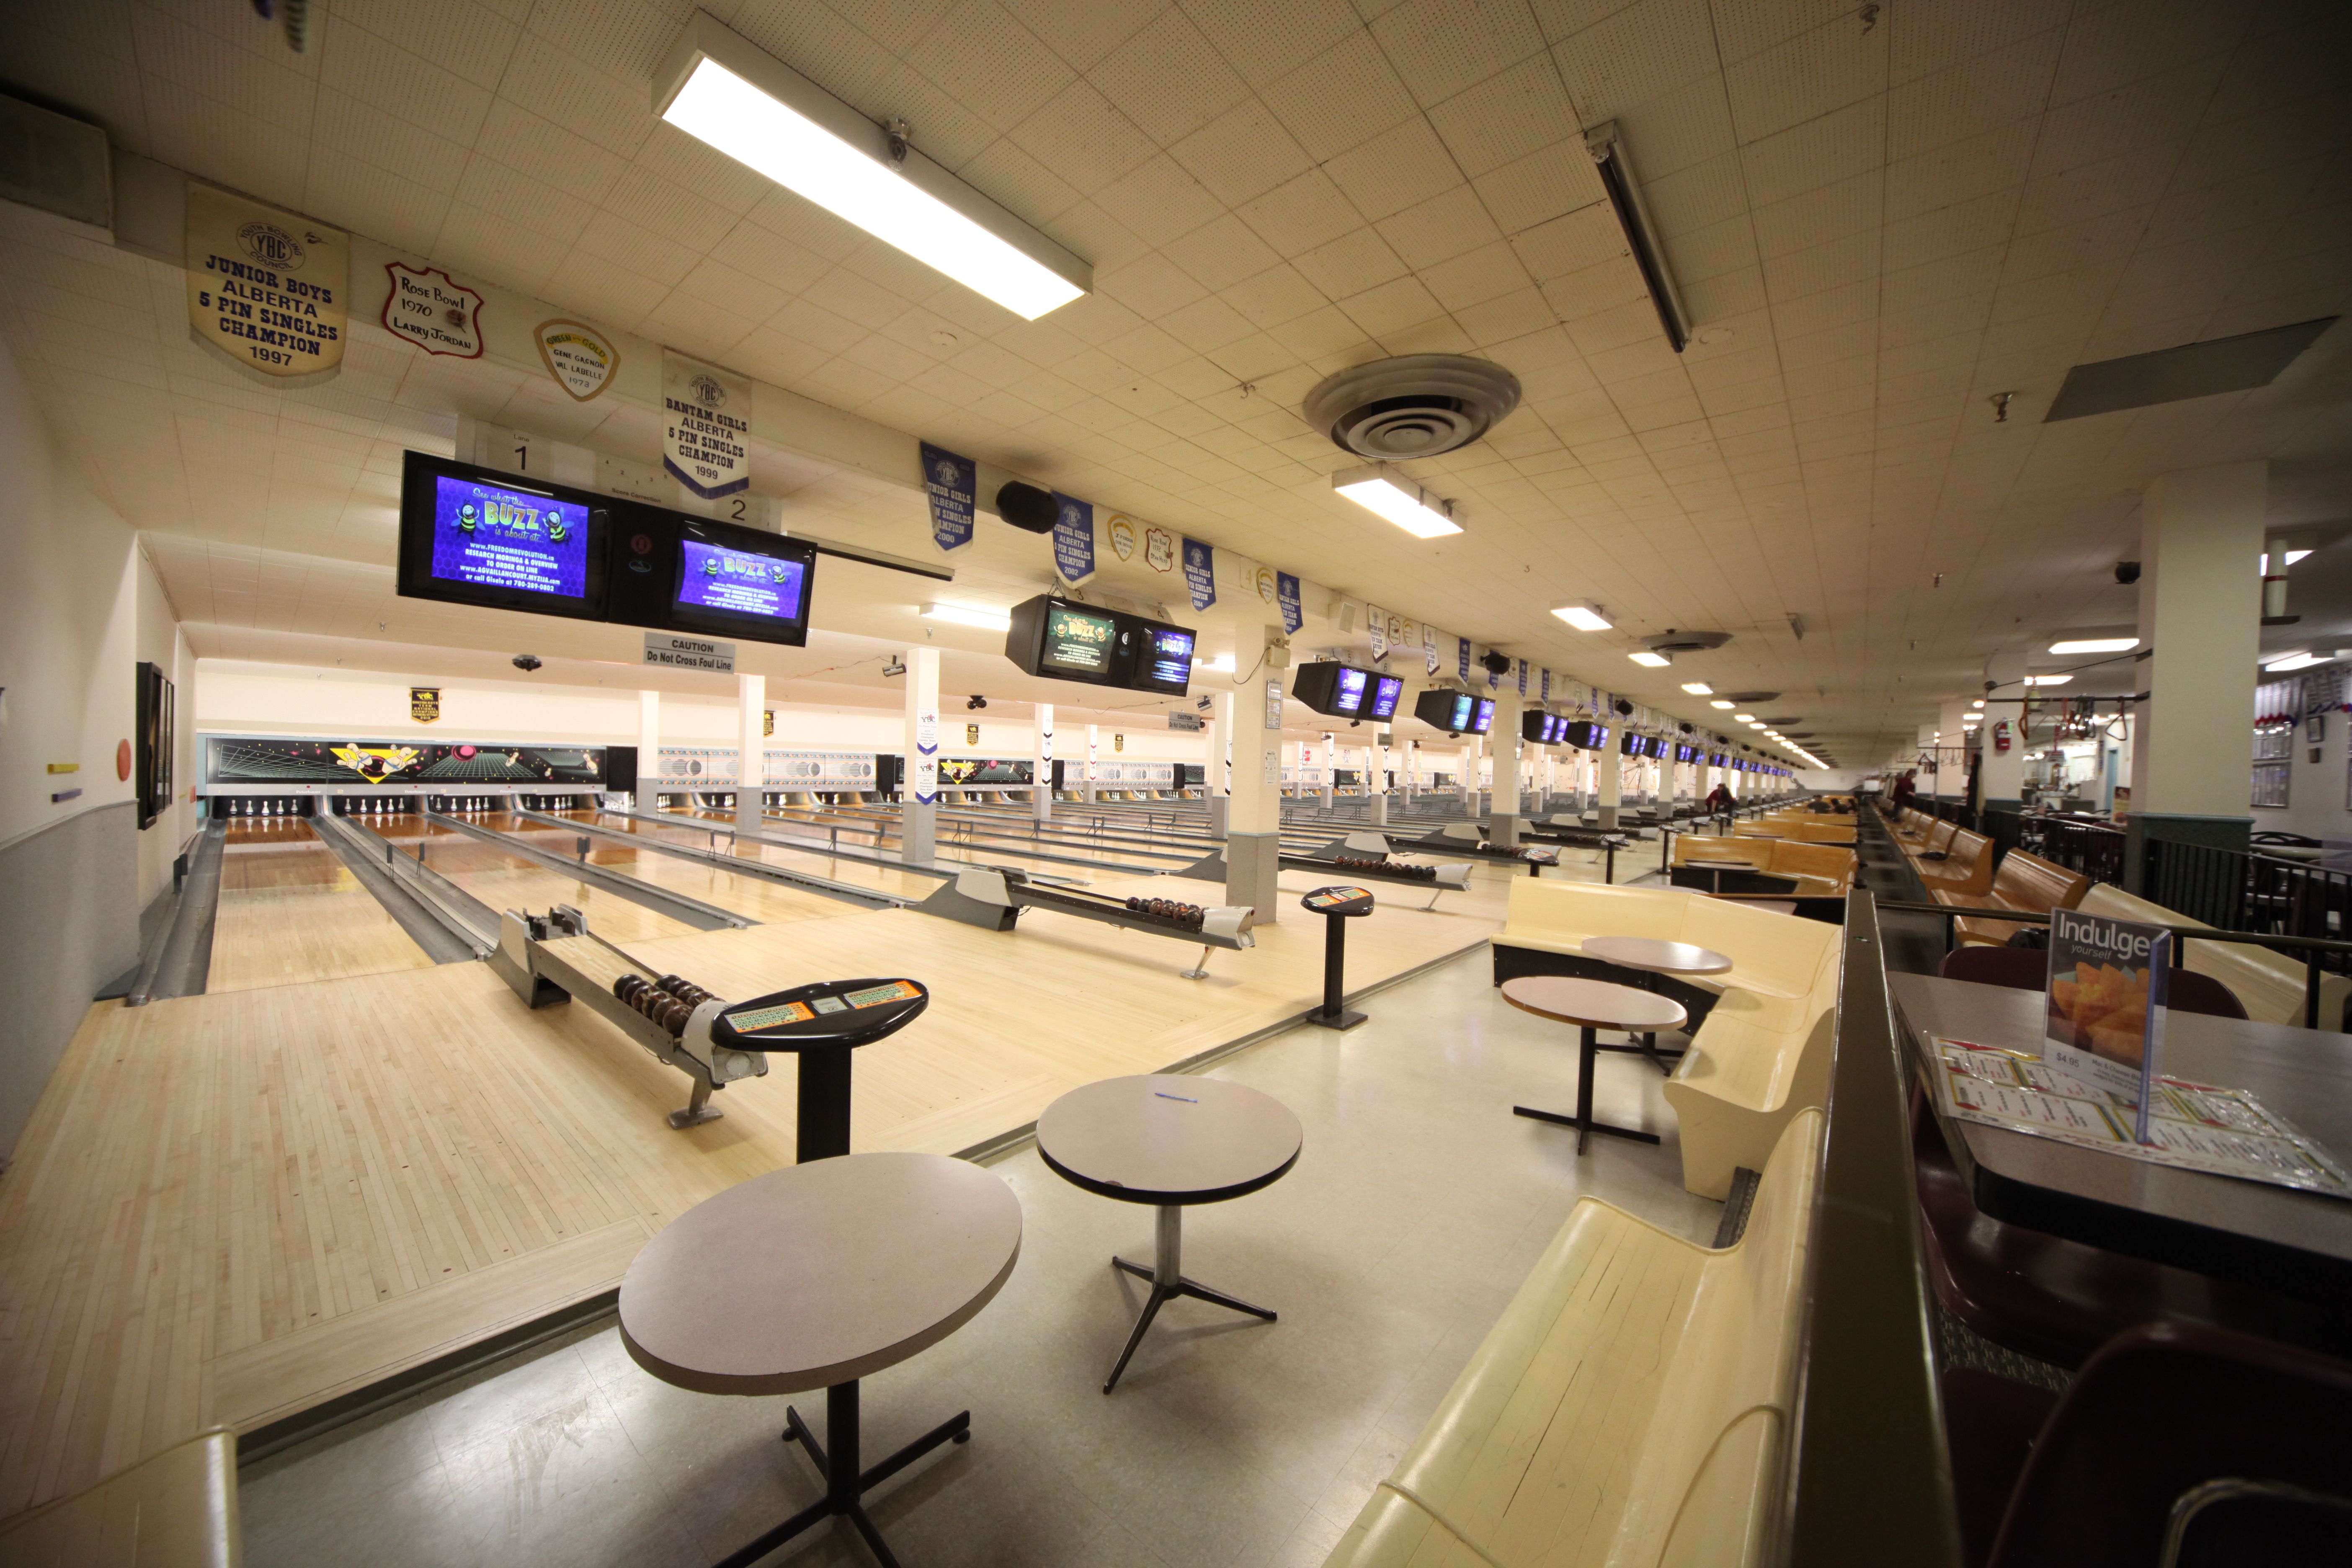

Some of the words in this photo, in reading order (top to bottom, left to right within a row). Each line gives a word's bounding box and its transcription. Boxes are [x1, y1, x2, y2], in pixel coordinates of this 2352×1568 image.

[240, 224, 264, 239] YOUTH
[267, 226, 302, 256] BOWLING
[257, 235, 286, 259] YBC
[250, 251, 294, 269] COUNCIL
[206, 254, 279, 288] JUNIOR
[286, 277, 333, 304] BOYS
[222, 280, 317, 318] ALBERTA
[402, 298, 432, 316] 1970
[199, 291, 210, 307] 5
[218, 296, 252, 319] PIN
[260, 308, 338, 340] SINGLES
[219, 317, 320, 356] CHAMPION
[547, 334, 571, 344] GREEN
[582, 339, 606, 357] GOLD
[249, 346, 292, 366] 1997
[554, 349, 572, 359] GENE
[575, 355, 604, 369] GAGNON
[556, 361, 568, 370] VAL
[572, 366, 602, 380] LABELLE
[569, 377, 589, 388] 1973
[691, 376, 704, 387] YOUTH
[705, 377, 725, 397] BOWLING
[699, 383, 716, 401] YBC
[696, 396, 720, 407] COUNCIL
[666, 397, 713, 422] BANTAM
[717, 414, 747, 432] GIRLS
[681, 417, 733, 441] ALBERTA
[669, 427, 674, 438] 5
[678, 429, 697, 444] PIN
[701, 436, 744, 458] SINGLES
[515, 446, 526, 470] 1
[679, 444, 733, 469] CHAMPION
[695, 465, 718, 479] 1999
[943, 467, 953, 481] YBC
[472, 487, 489, 498] See
[491, 493, 511, 502] what
[631, 493, 661, 503] Correction
[951, 490, 971, 504] GIRLS
[485, 501, 539, 530] BUZZ
[731, 499, 746, 521] 2
[943, 511, 972, 524] SINGLES
[495, 526, 501, 535] is
[505, 528, 529, 539] about
[938, 519, 965, 534] AMPION
[1055, 524, 1073, 536] JUNIOR
[1075, 529, 1090, 541] GIRLS
[938, 531, 954, 543] 2000
[1059, 535, 1084, 549] ALBERTA
[465, 549, 495, 559] RESEARCH
[496, 554, 523, 564] MORINGA
[531, 559, 558, 569] OVERVIEW
[1058, 544, 1067, 553] PIN
[1068, 548, 1091, 560] SINGLES
[496, 562, 515, 570] ORDER
[724, 557, 766, 576] BUZZ
[1059, 554, 1085, 568] CHAMPION
[1065, 566, 1078, 576] 2002
[1189, 574, 1207, 584] ALBERTA
[1199, 569, 1210, 578] GIRLS
[514, 580, 554, 592] 780-289-0802
[1195, 583, 1212, 593] SINGLES
[1075, 589, 1084, 600] 3
[1158, 610, 1164, 619] 4
[672, 640, 714, 653] CAUTION
[647, 650, 657, 661] Do
[660, 652, 673, 663] Not
[676, 655, 696, 666] Cross
[699, 658, 714, 668] Foul
[717, 659, 731, 670] Line
[1348, 654, 1351, 663] 5
[1384, 663, 1387, 672] 6
[2059, 913, 2151, 960] Indulge
[2071, 944, 2112, 960] yourself
[2056, 1052, 2079, 1068] $4.95
